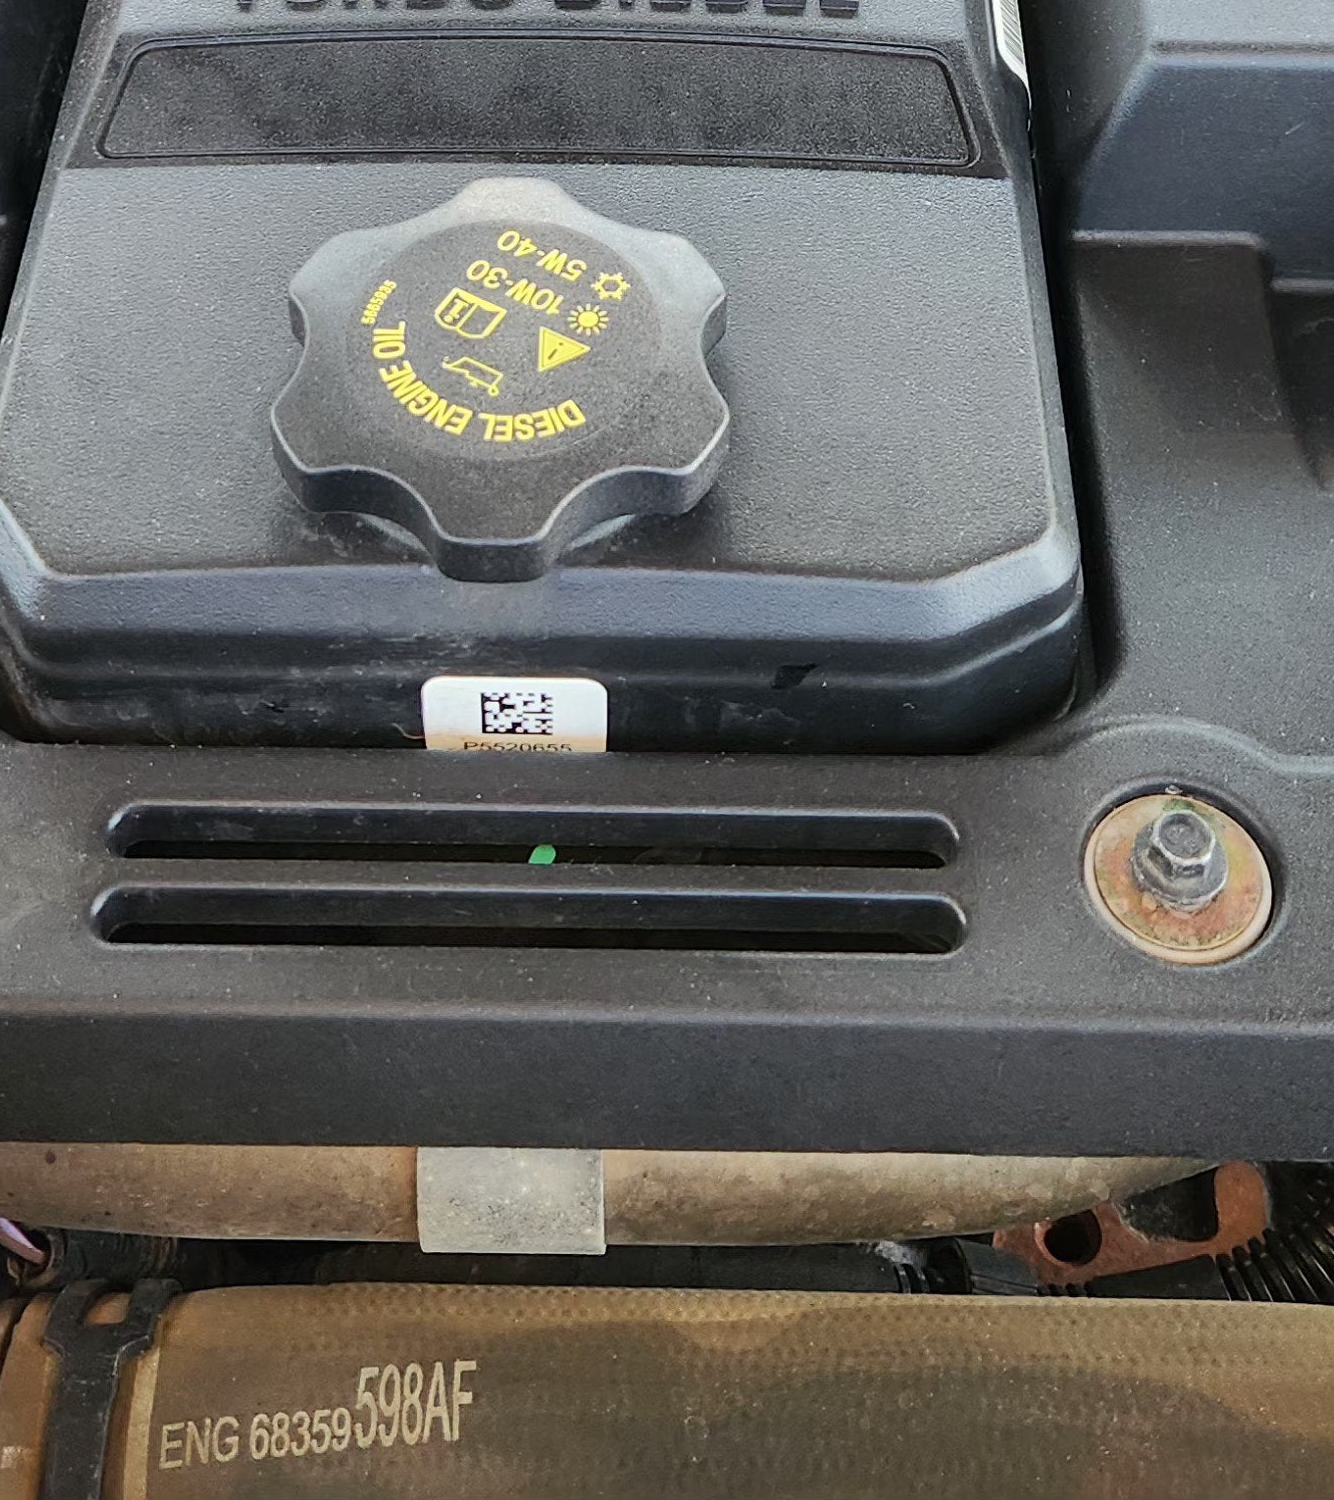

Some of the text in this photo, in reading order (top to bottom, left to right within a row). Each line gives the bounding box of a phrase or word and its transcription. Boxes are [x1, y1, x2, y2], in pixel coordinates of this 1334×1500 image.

[496, 229, 588, 282] 5W-40
[465, 259, 565, 316] 10W-30
[371, 320, 587, 442] DIESEL ENGINE OIL
[159, 1415, 241, 1470] ENG
